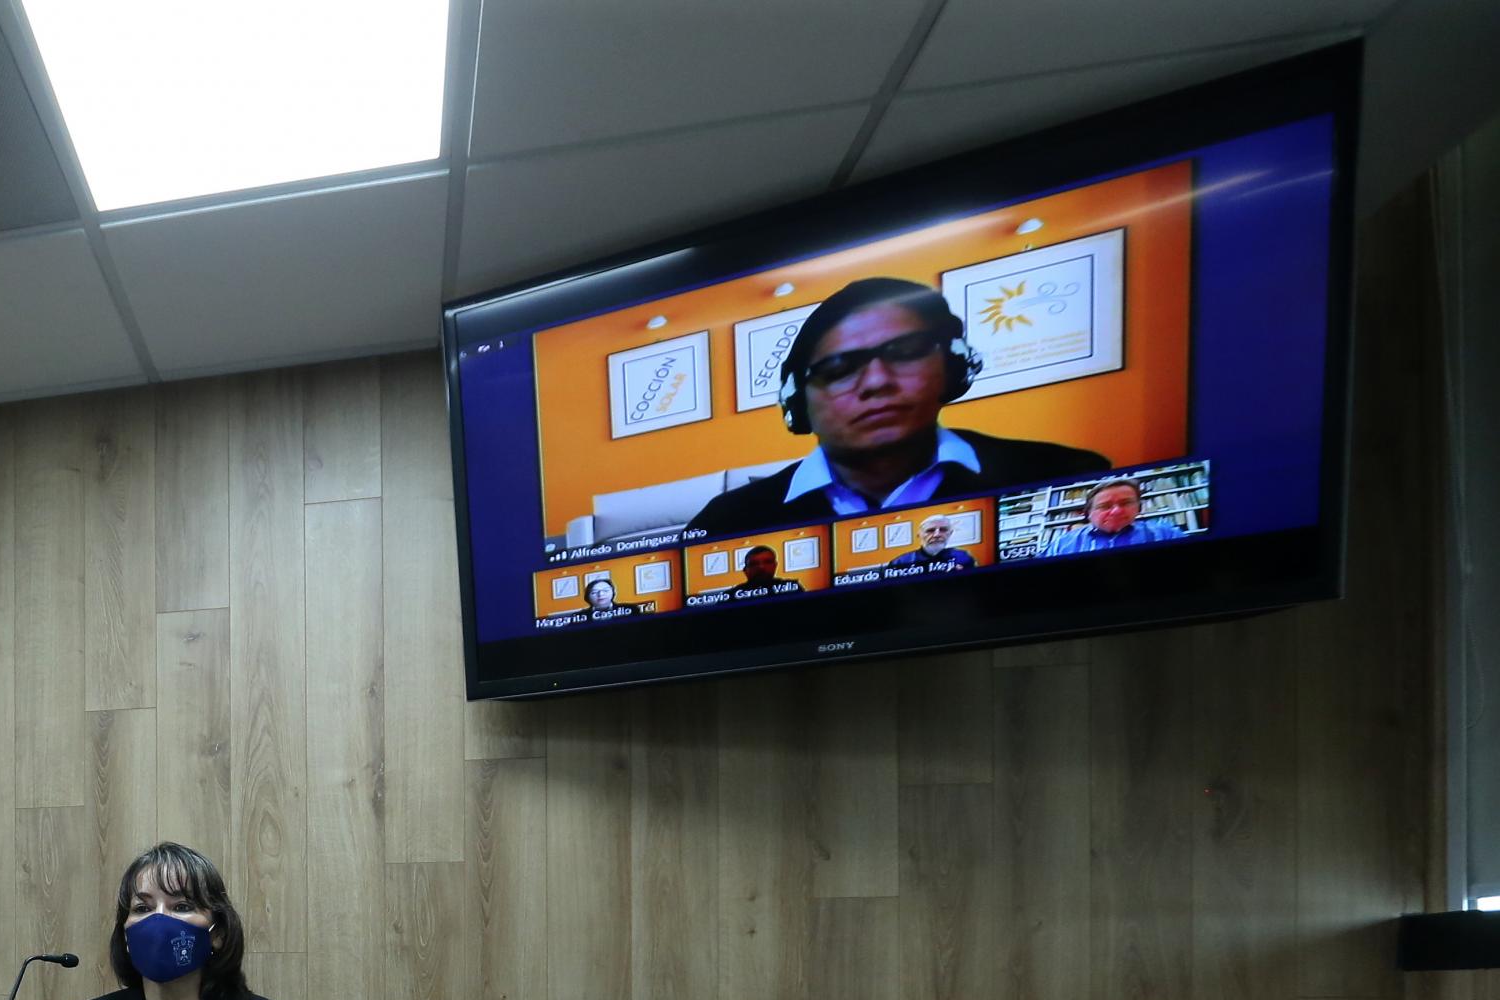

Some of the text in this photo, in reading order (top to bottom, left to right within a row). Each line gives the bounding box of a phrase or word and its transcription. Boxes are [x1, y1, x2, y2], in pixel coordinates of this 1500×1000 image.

[754, 324, 799, 388] SECADO
[630, 357, 677, 421] COCCIÓN
[570, 544, 612, 559] Alfredo
[616, 533, 679, 552] Domínguez
[1000, 546, 1036, 560] USER
[834, 571, 880, 586] Eduardo
[884, 562, 924, 578] Rincón
[686, 592, 730, 606] Octavio
[536, 613, 588, 628] Margarita
[592, 607, 632, 620] Castillo
[818, 641, 855, 653] SONY
